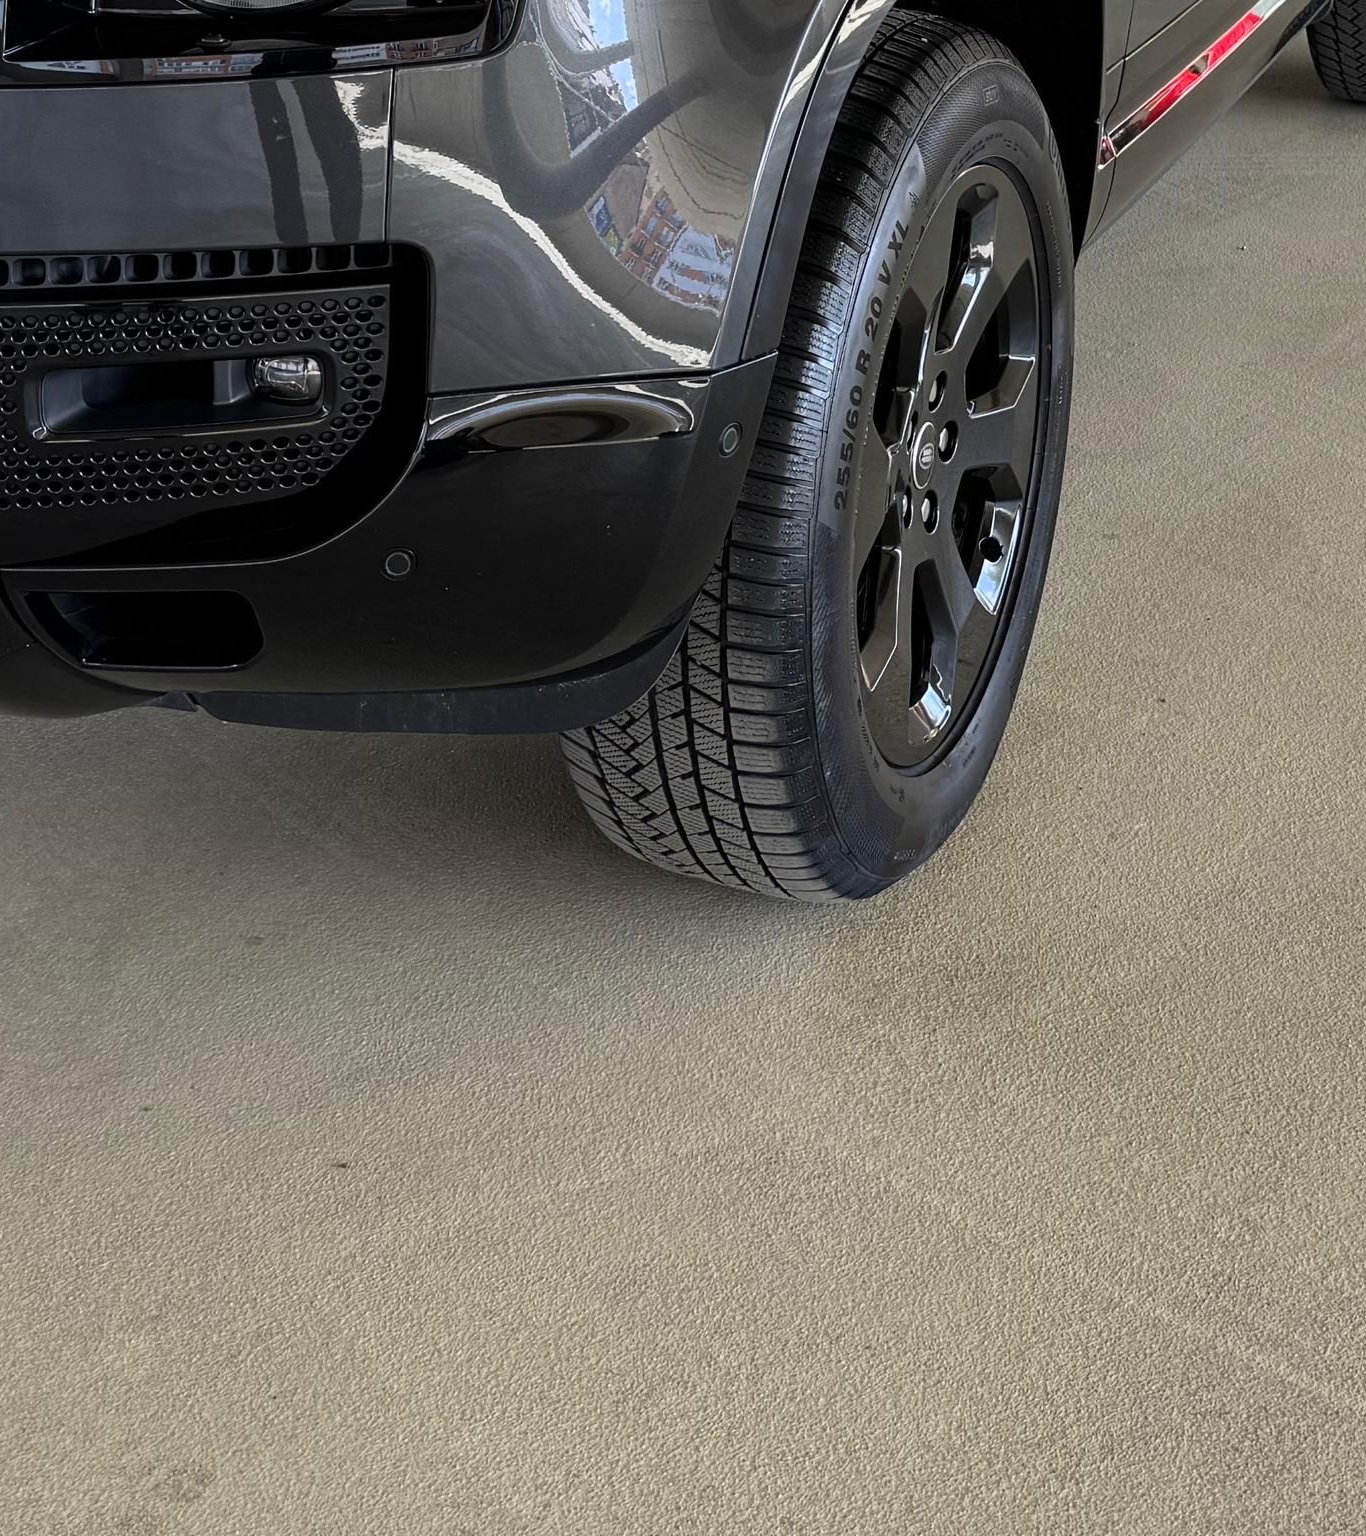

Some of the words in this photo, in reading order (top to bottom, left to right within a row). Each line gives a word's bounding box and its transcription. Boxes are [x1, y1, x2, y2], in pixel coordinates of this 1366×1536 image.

[835, 384, 863, 511] 255/60
[855, 356, 871, 377] R
[865, 296, 883, 338] 20
[877, 259, 893, 287] V
[887, 219, 911, 261] XL
